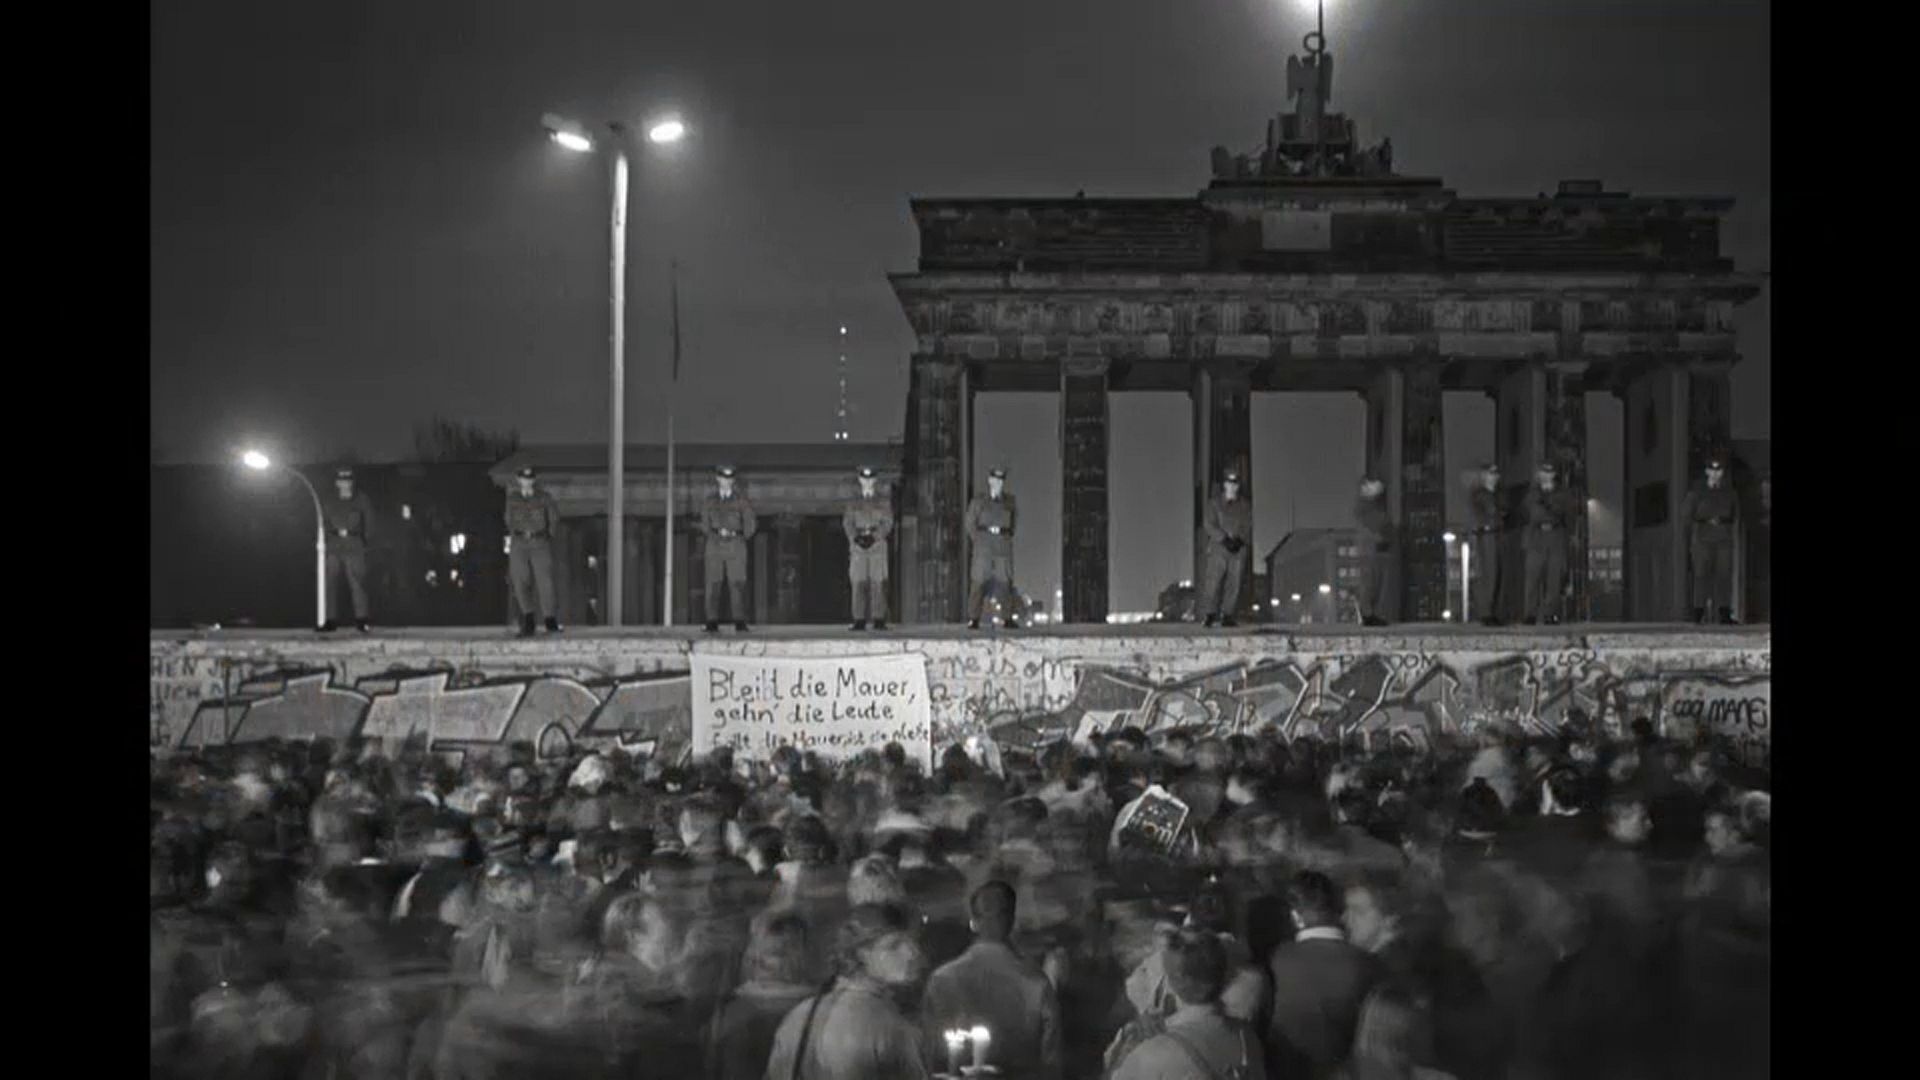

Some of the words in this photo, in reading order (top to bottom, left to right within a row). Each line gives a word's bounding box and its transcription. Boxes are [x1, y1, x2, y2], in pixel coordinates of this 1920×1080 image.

[789, 667, 828, 697] die
[834, 666, 917, 704] Mauer,
[787, 703, 826, 724] die
[831, 702, 895, 720] Leute
